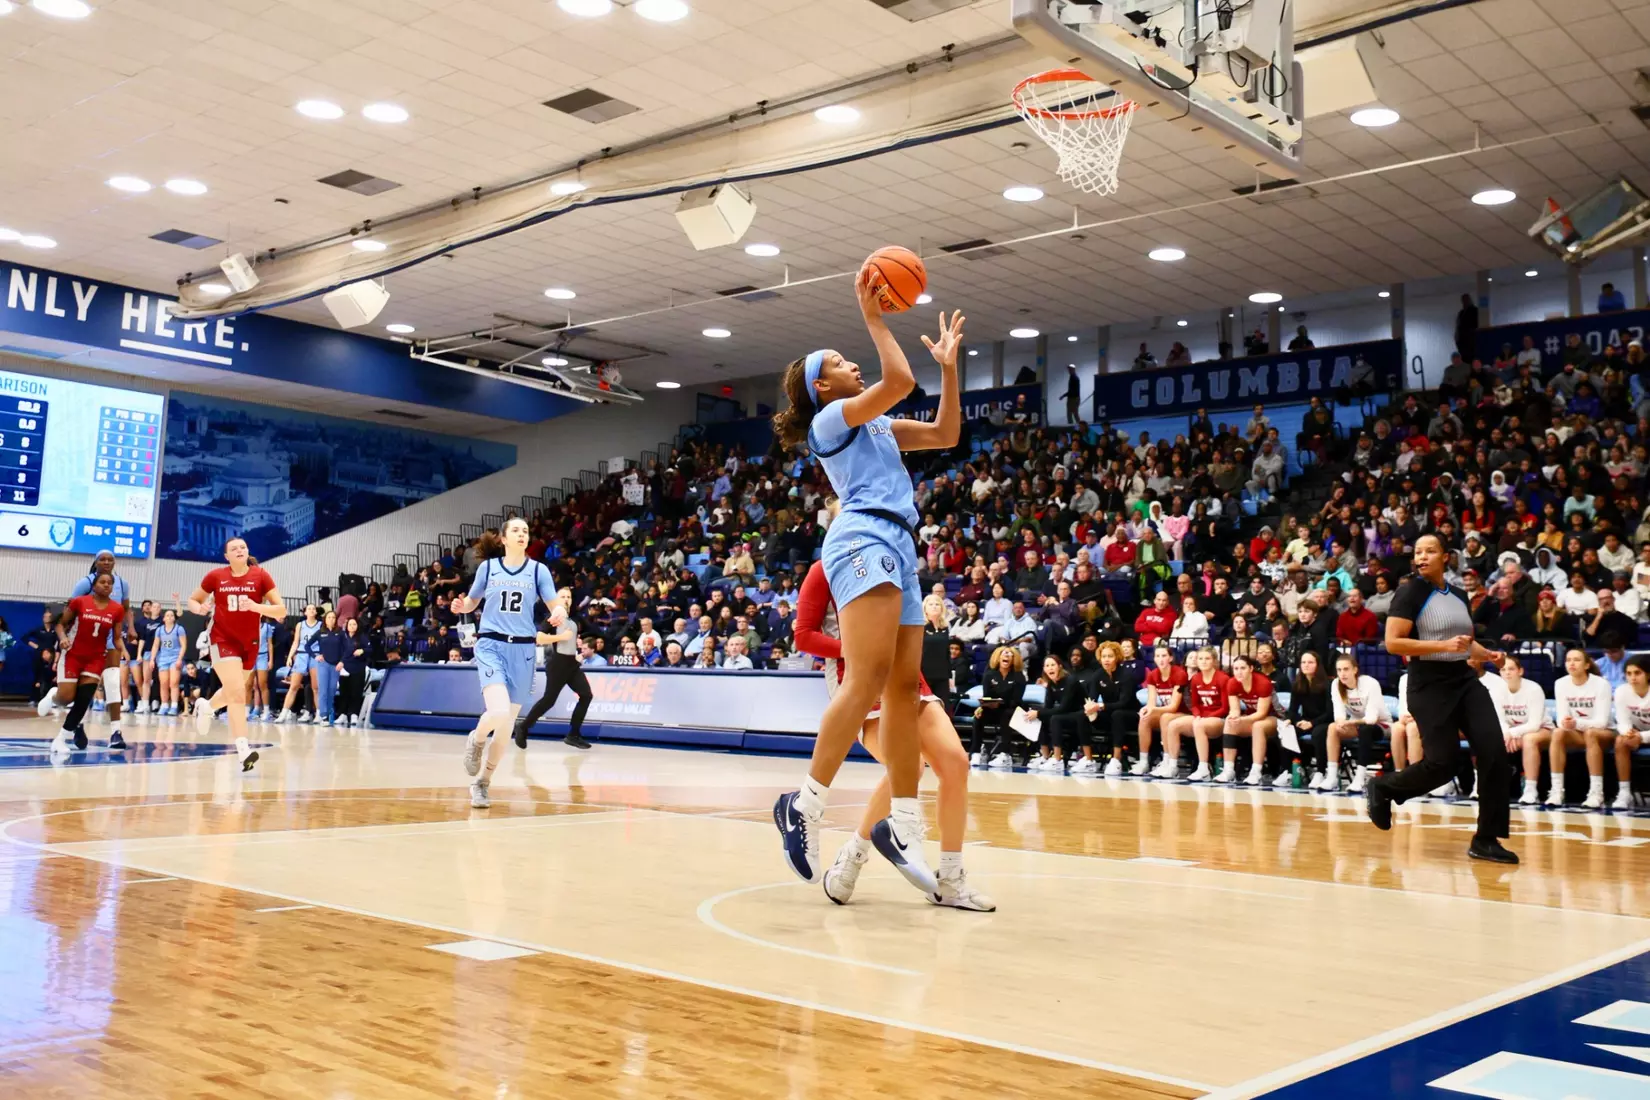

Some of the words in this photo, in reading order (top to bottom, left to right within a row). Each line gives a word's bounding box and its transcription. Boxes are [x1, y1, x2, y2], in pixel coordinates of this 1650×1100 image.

[1131, 356, 1351, 408] COLUMBIA
[17, 524, 29, 536] 6
[489, 579, 533, 590] COLUMBIA
[499, 590, 523, 614] 12
[92, 622, 101, 637] 1
[613, 655, 633, 665] POSS
